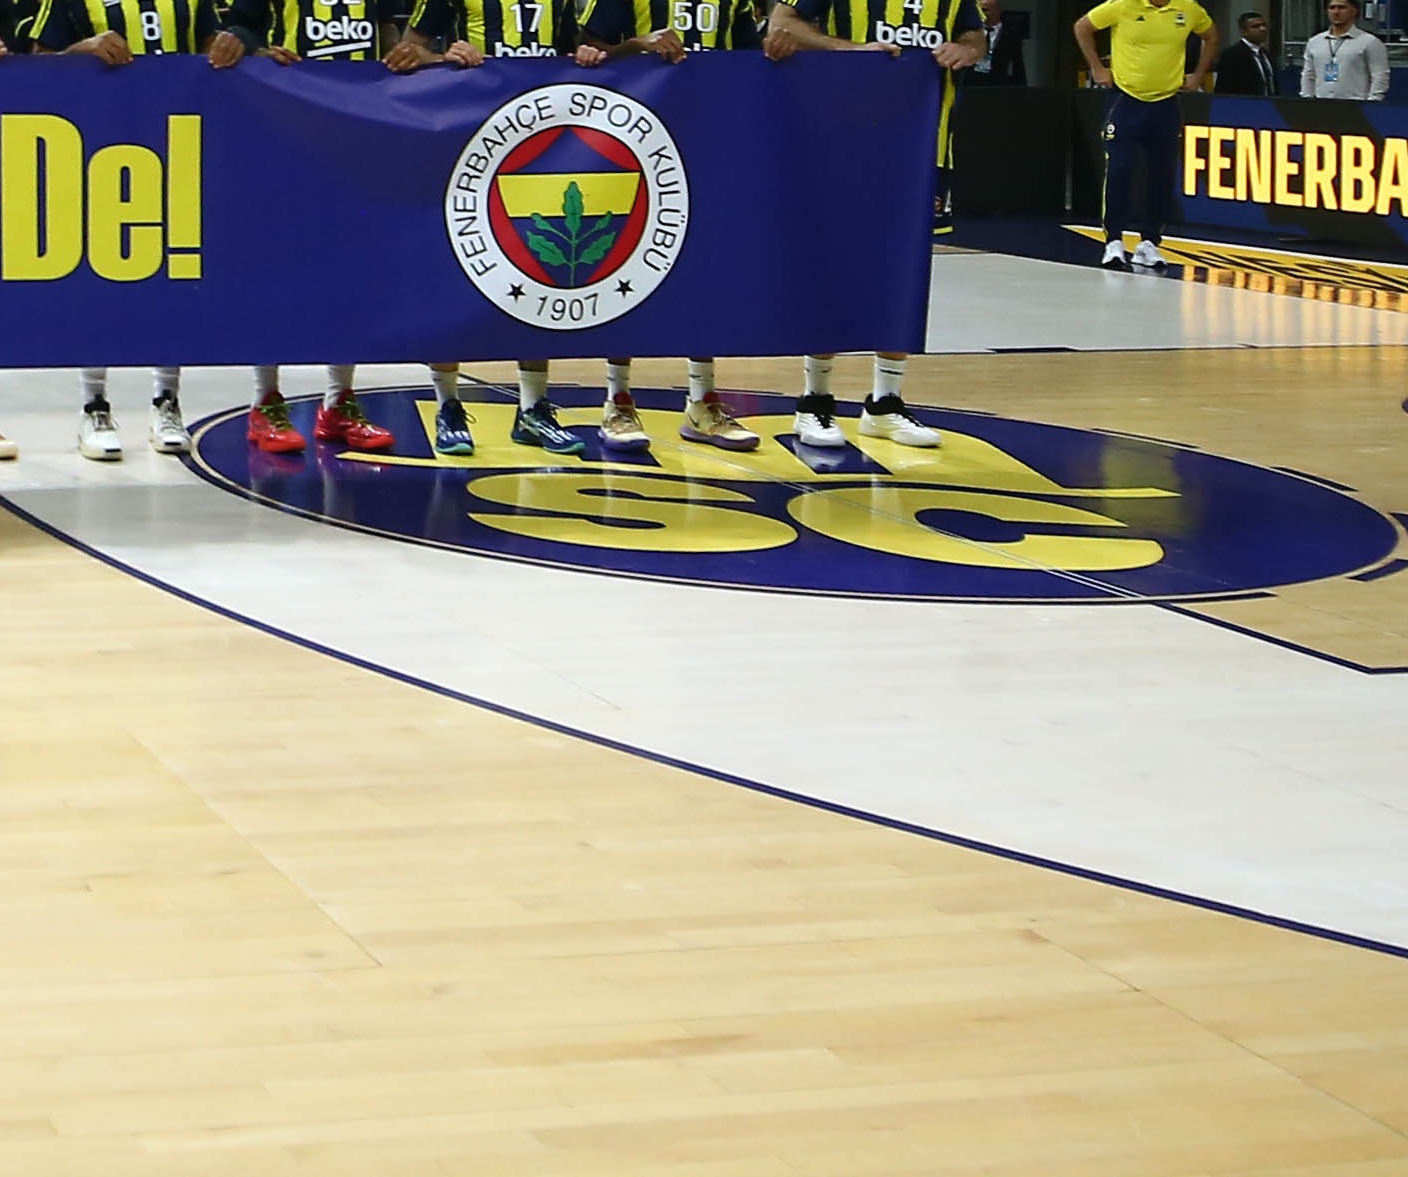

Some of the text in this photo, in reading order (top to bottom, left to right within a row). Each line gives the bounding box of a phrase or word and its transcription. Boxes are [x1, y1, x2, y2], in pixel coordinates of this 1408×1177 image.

[141, 11, 162, 41] 8
[305, 16, 373, 41] beko
[510, 4, 544, 32] 17
[674, 1, 718, 32] 50
[875, 20, 943, 49] beko
[0, 114, 202, 282] De!
[454, 92, 687, 277] FENERBAHÇE SPOR KULÜBÜ
[535, 292, 600, 322] 1907
